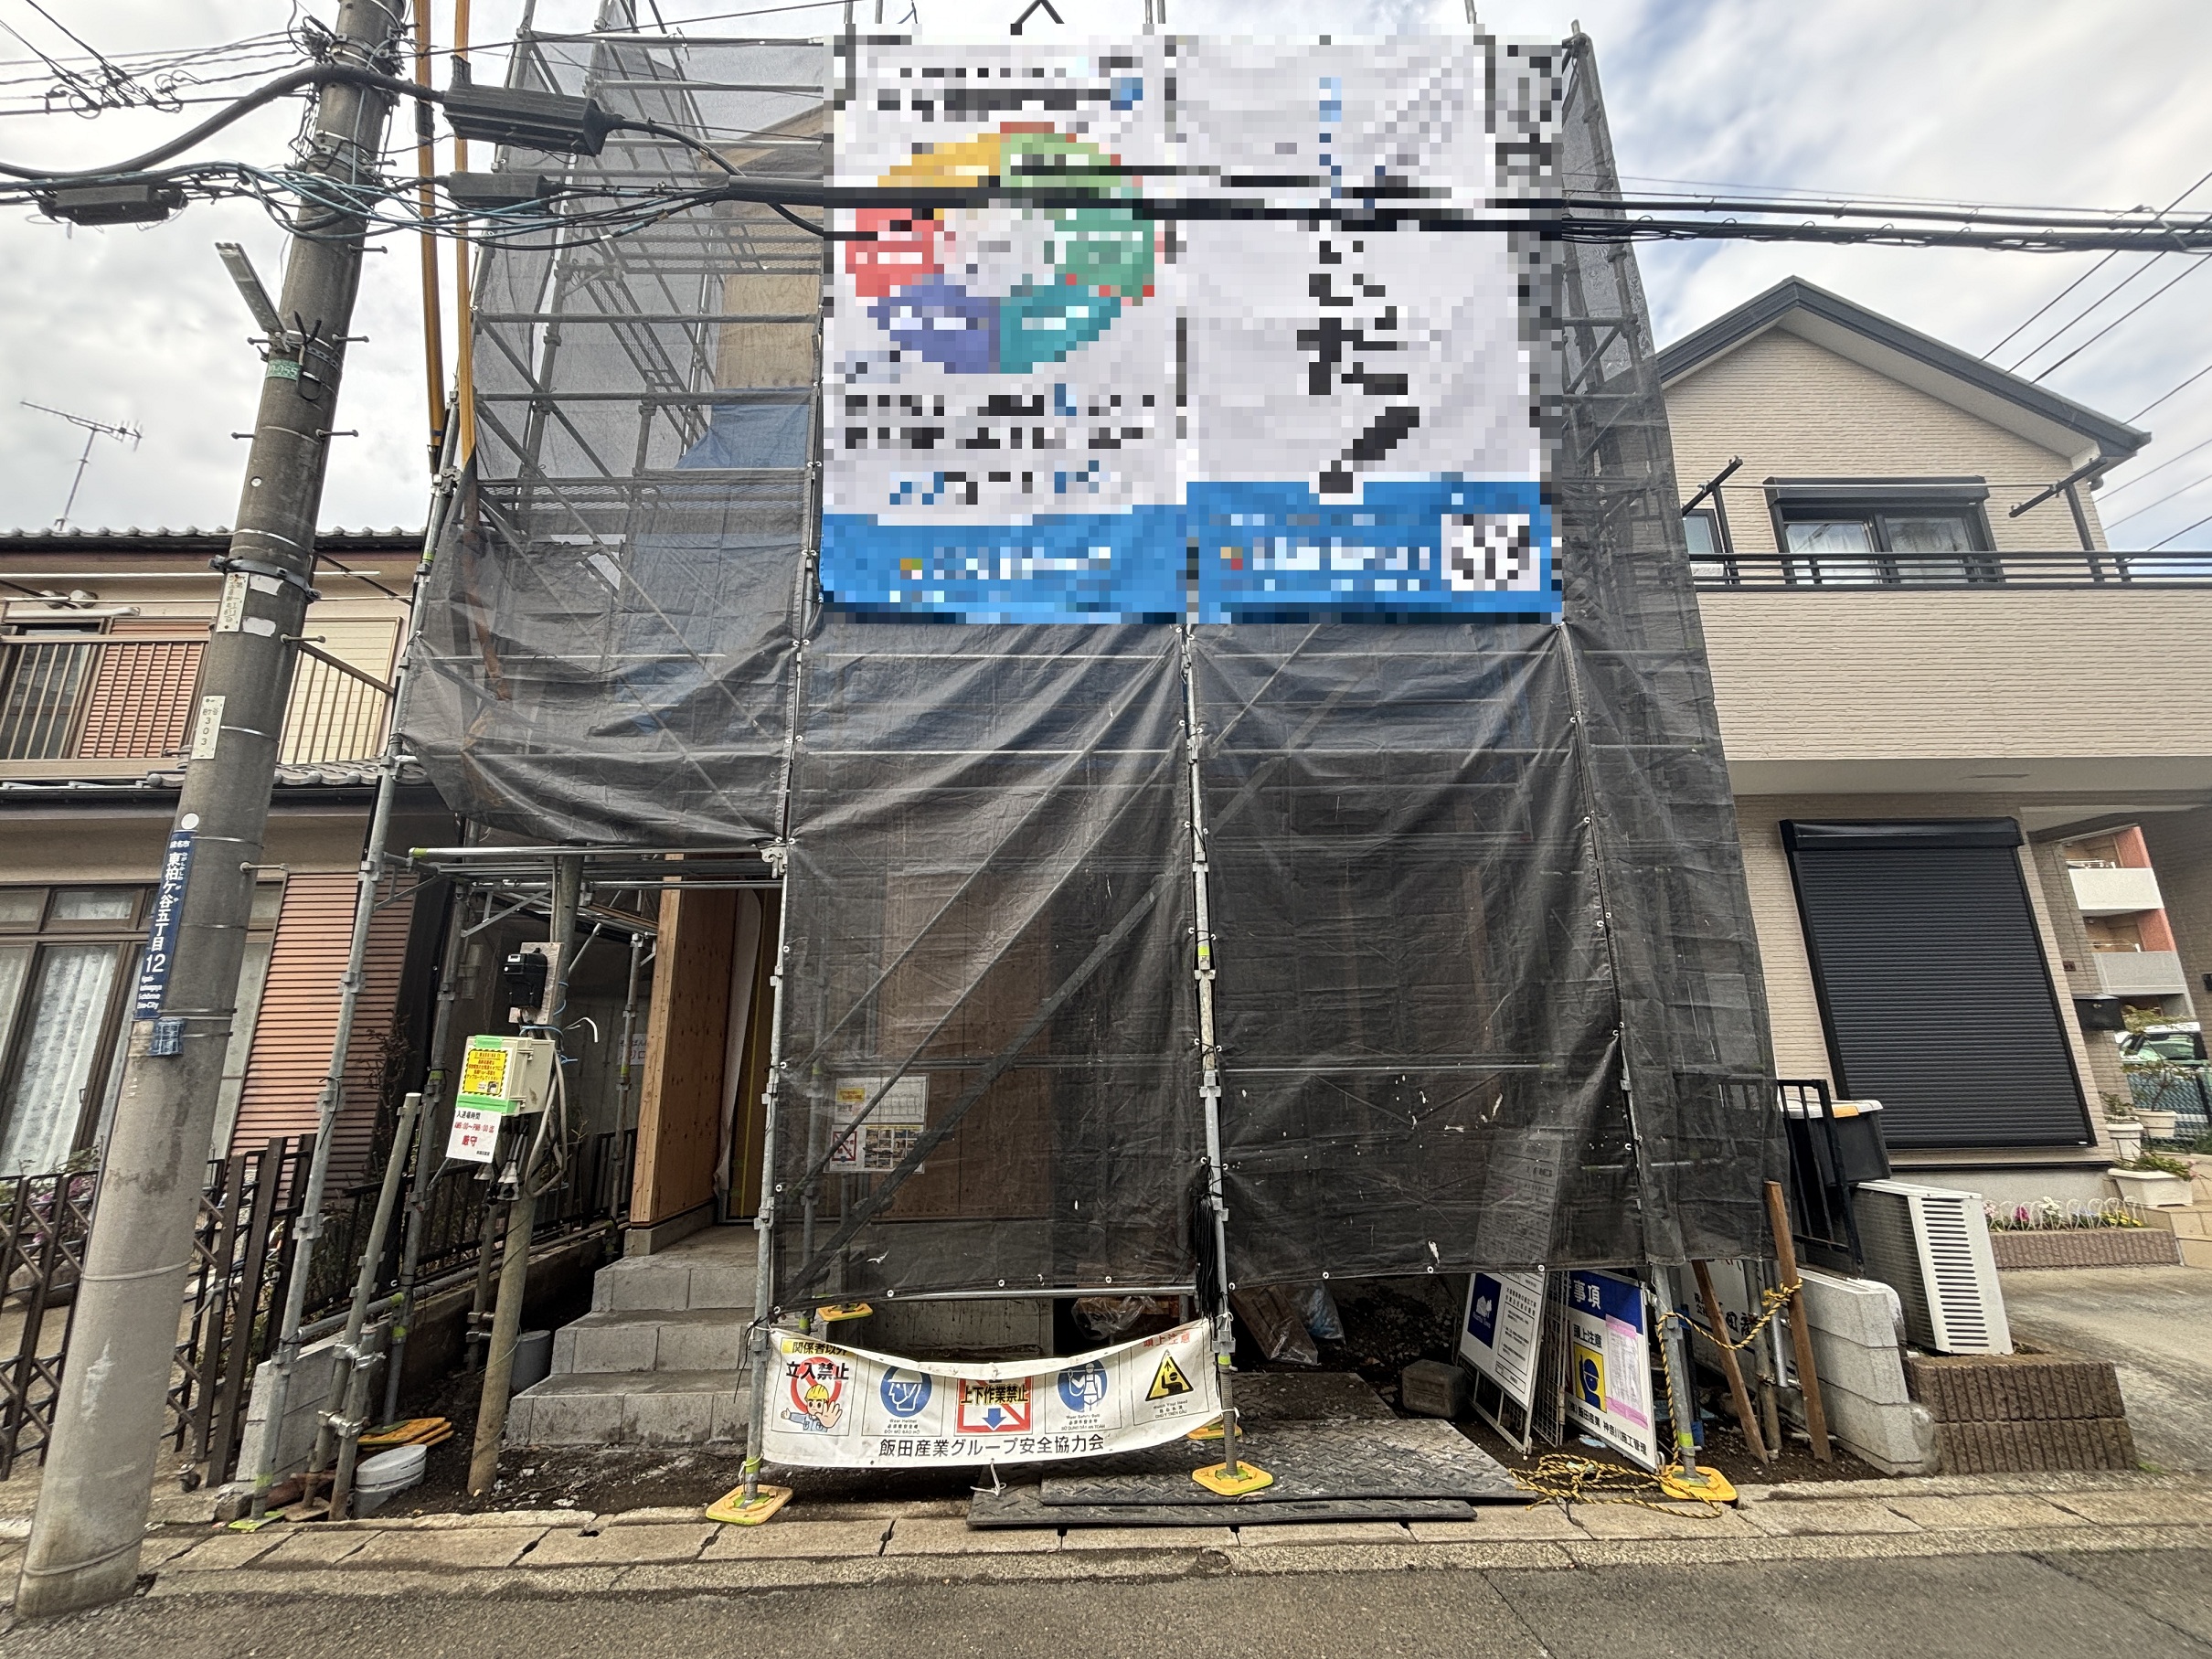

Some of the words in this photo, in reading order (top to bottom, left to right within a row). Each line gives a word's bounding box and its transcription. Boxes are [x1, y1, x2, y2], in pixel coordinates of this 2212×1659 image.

[146, 953, 166, 973] 12
[1566, 1279, 1601, 1311] 事項
[1573, 1324, 1603, 1349] 頭上注意
[786, 1360, 850, 1381] 立入禁止
[960, 1384, 1029, 1405] 上下作業禁止
[878, 1433, 1104, 1458] 飯田産業グループ安全協力会
[1602, 1420, 1648, 1456] 神奈川施工管理
